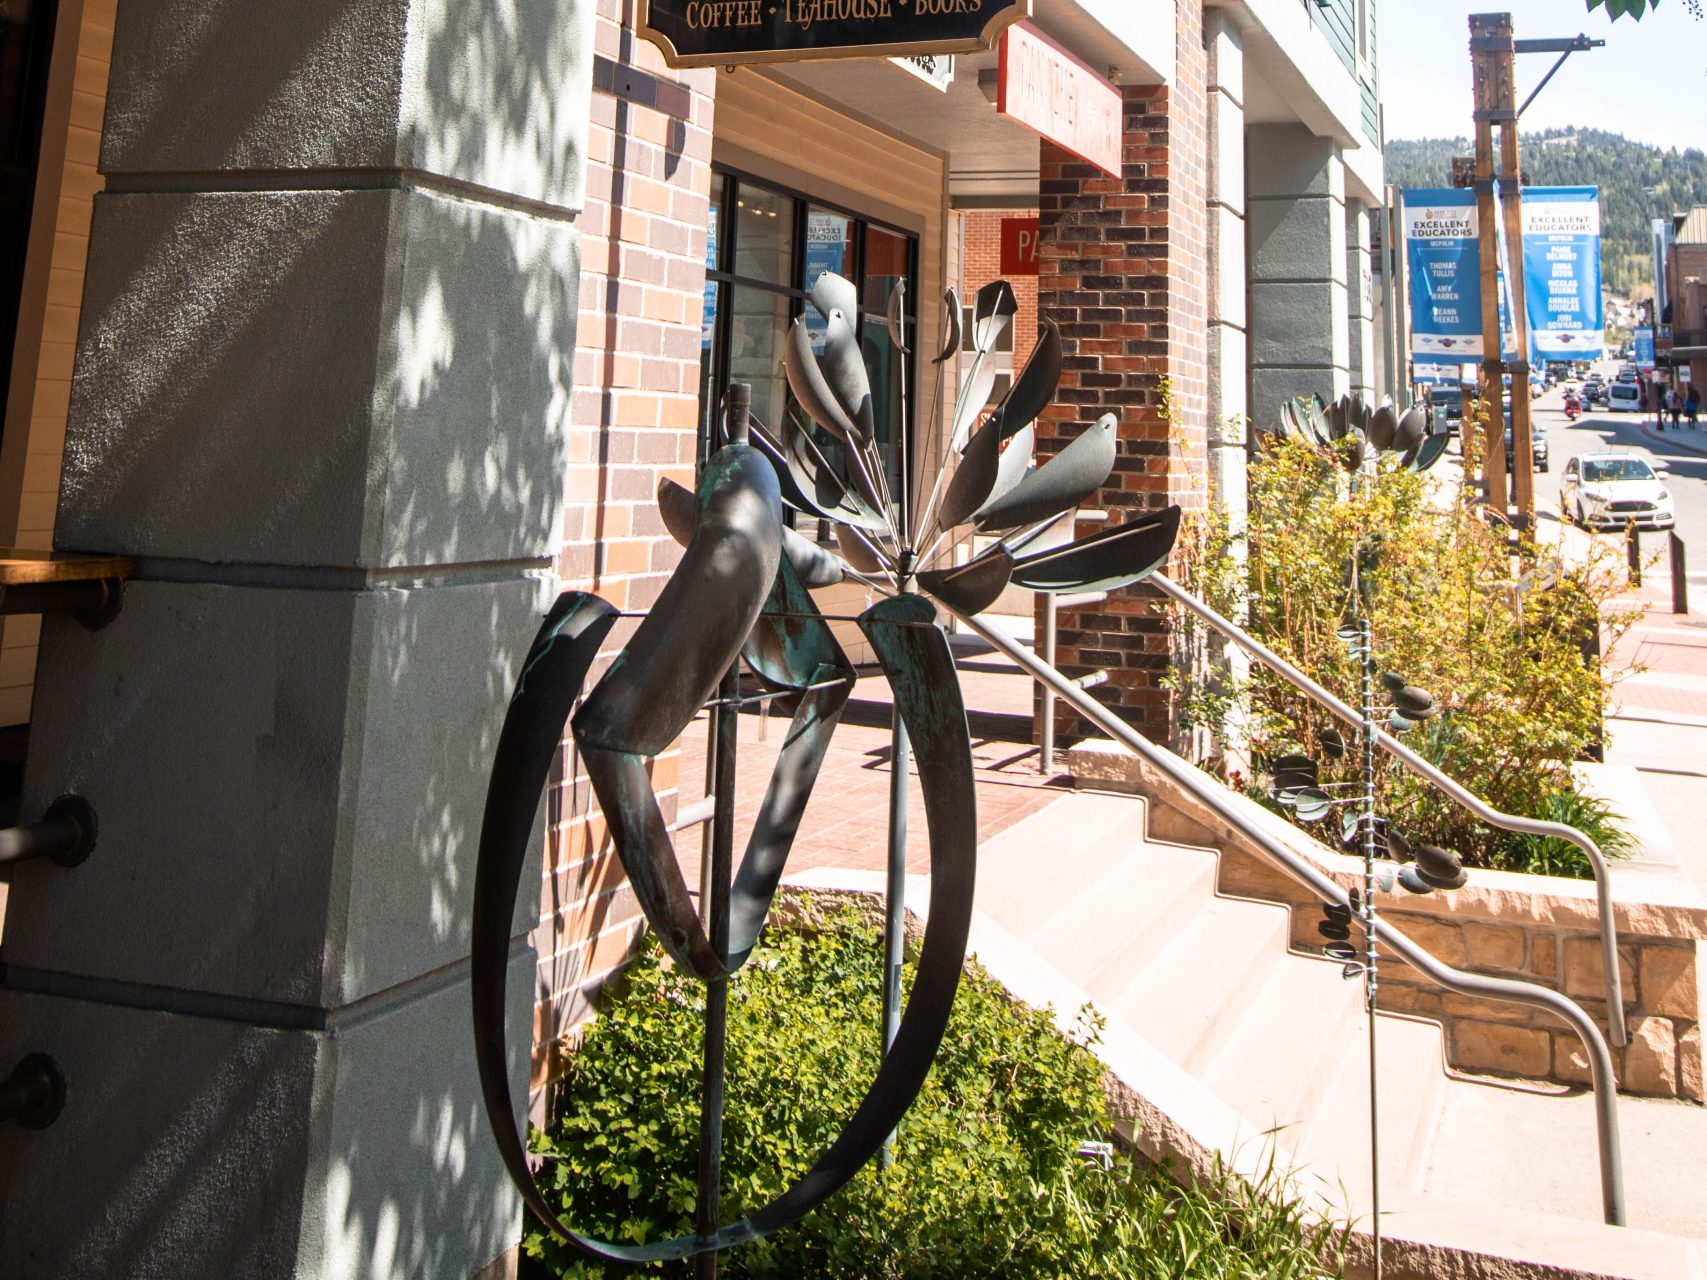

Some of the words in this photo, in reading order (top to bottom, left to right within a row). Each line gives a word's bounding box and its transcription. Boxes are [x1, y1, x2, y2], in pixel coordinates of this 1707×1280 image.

[686, 0, 762, 29] COFFEE
[1412, 229, 1472, 237] EDUCATORS
[1548, 304, 1580, 312] DOUGLAS
[1432, 315, 1459, 323] WEEKES
